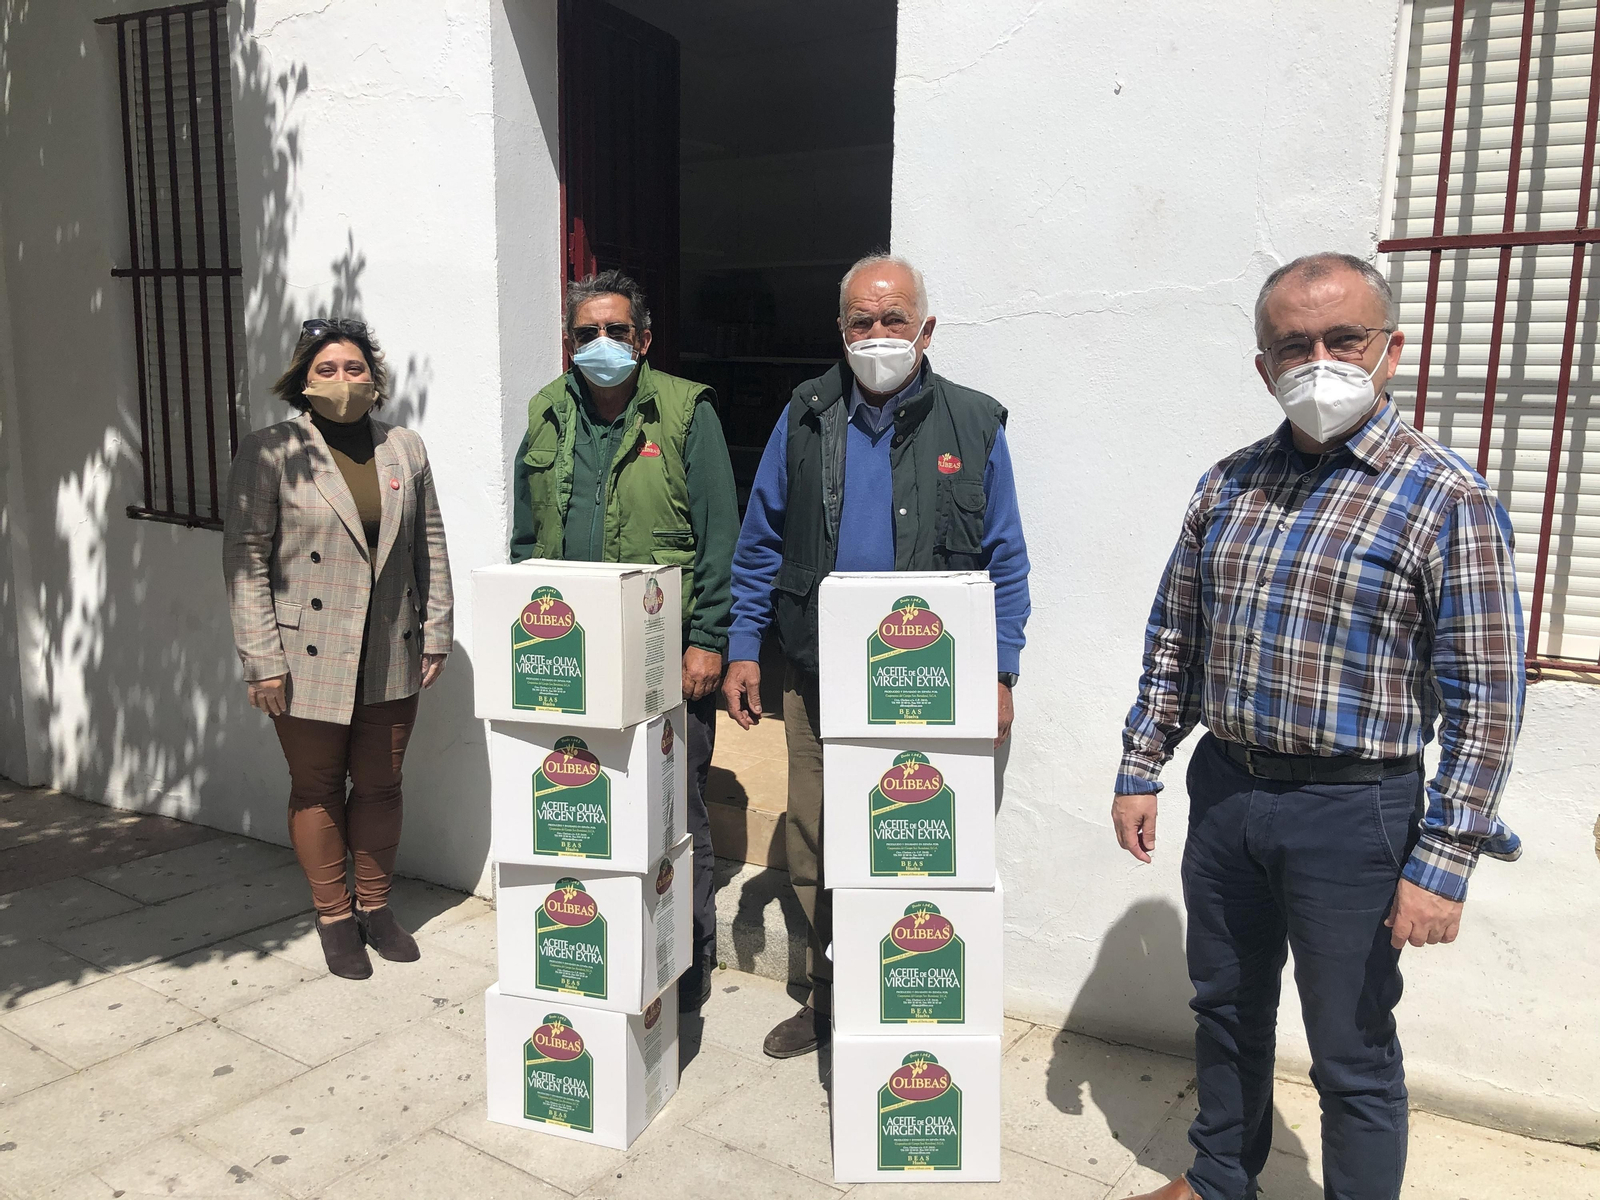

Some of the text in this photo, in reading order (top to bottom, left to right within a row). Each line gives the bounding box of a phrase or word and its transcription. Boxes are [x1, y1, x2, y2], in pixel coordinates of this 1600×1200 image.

[523, 612, 572, 627] OLIBEAS
[882, 623, 939, 636] OLIBEAS
[519, 654, 546, 665] ACEITE
[553, 656, 578, 666] OLIVA
[516, 662, 581, 677] VIRGEN EXTRA
[877, 666, 907, 676] ACEITE
[917, 666, 946, 676] OLIVA
[872, 676, 950, 687] VIRGEN EXTRA
[546, 761, 597, 775] OLIBEAS
[884, 777, 939, 790] OLIBEAS
[541, 801, 569, 812] ACEITE
[577, 803, 603, 813] OLIVA
[537, 810, 607, 823] VIRGEN EXTRA
[878, 820, 908, 829] ACEITE
[918, 820, 947, 829] OLIVA
[874, 829, 951, 840] VIRGEN EXTRA
[547, 900, 595, 917] OLIBEAS
[895, 927, 950, 939] OLIBEAS
[543, 938, 568, 950] ACEITE
[576, 942, 600, 954] OLIVA
[540, 946, 604, 964] VIRGEN EXTRA
[889, 968, 919, 977] ACEITE
[928, 968, 956, 978] OLIVA
[561, 978, 580, 986] BEAS
[885, 977, 960, 988] VIRGEN EXTRA
[535, 1034, 581, 1052] OLIBEAS
[531, 1070, 556, 1082] ACEITE
[563, 1076, 587, 1089] OLIVA
[892, 1076, 947, 1089] OLIBEAS
[528, 1077, 590, 1099] VIRGEN EXTRA
[548, 1110, 567, 1118] BEAS
[886, 1116, 916, 1126] ACEITE
[925, 1116, 953, 1126] OLIVA
[882, 1125, 957, 1135] VIRGEN EXTRA
